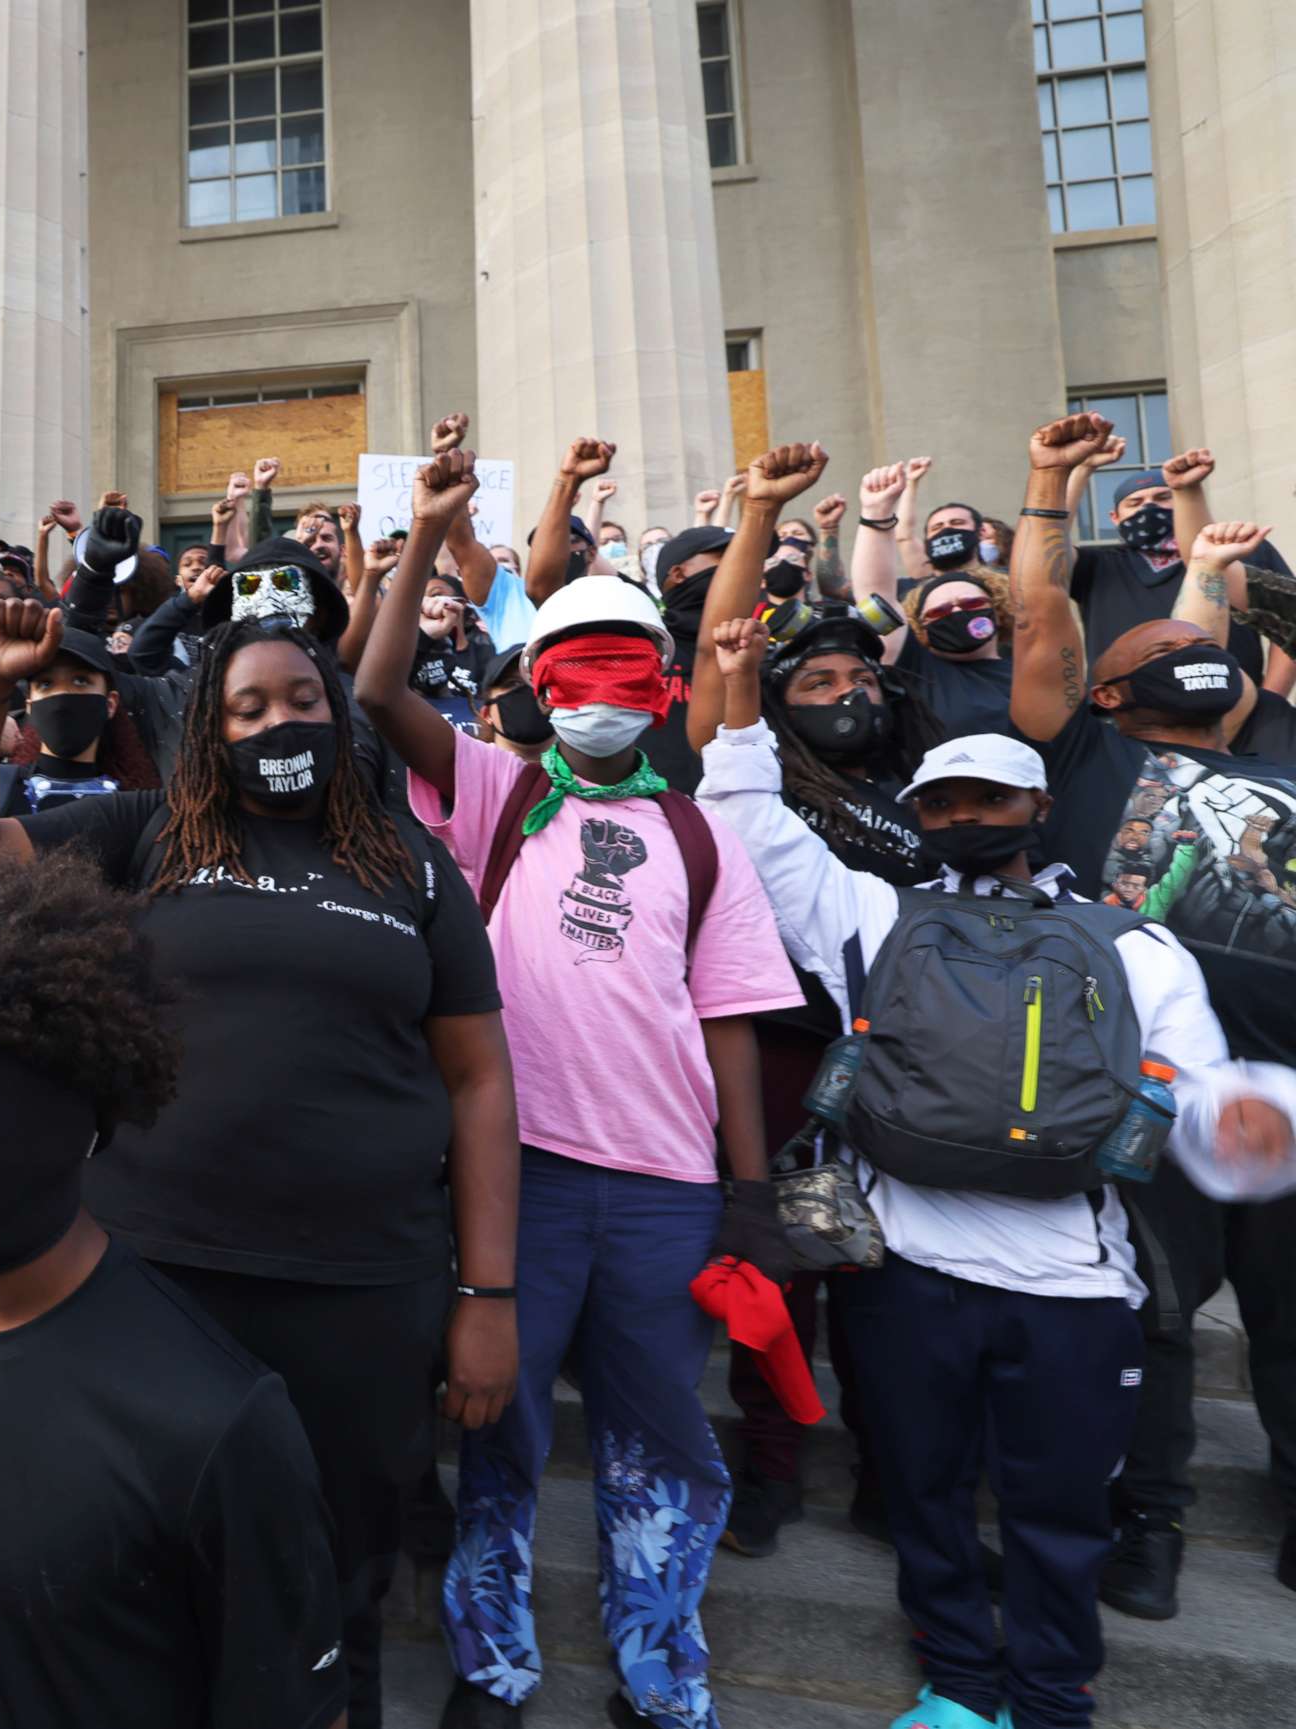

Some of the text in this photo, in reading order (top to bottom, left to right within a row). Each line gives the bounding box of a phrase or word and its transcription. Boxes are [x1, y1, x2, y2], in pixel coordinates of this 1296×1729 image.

[1181, 676, 1228, 691] TAYLOR
[259, 750, 315, 776] BREONNA
[266, 769, 314, 793] TAYLOR
[582, 885, 622, 904] BLACK
[382, 913, 417, 937] Floyd
[574, 906, 612, 923] LIVES
[566, 924, 614, 949] MATTER
